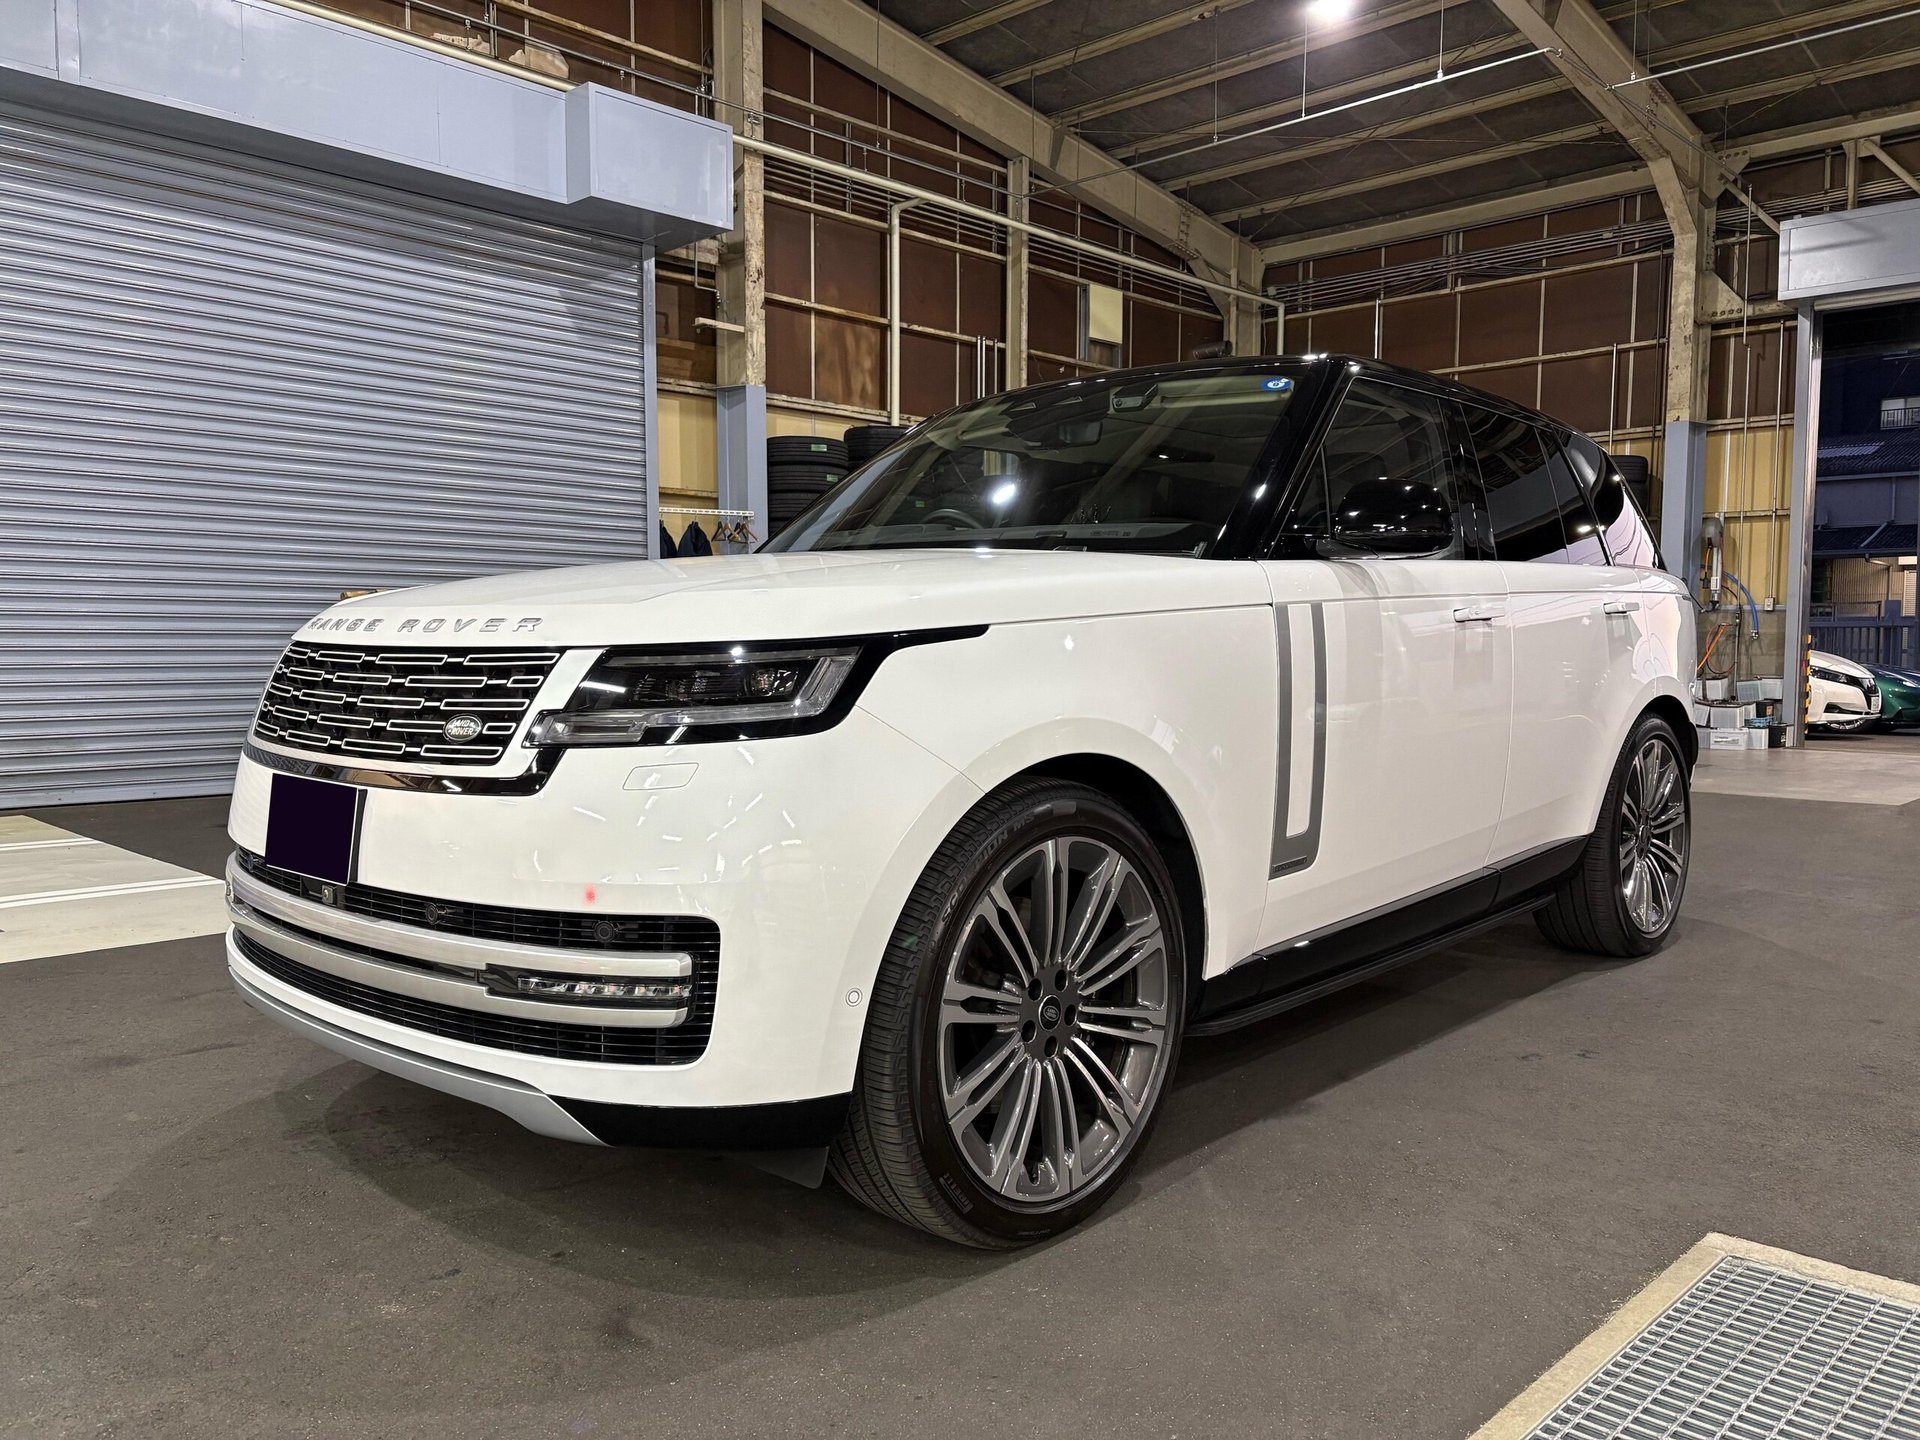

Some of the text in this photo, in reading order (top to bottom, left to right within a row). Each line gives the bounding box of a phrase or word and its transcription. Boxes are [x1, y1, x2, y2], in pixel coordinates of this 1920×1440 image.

[308, 618, 543, 632] RANGE ROVER
[450, 727, 474, 736] ROVER
